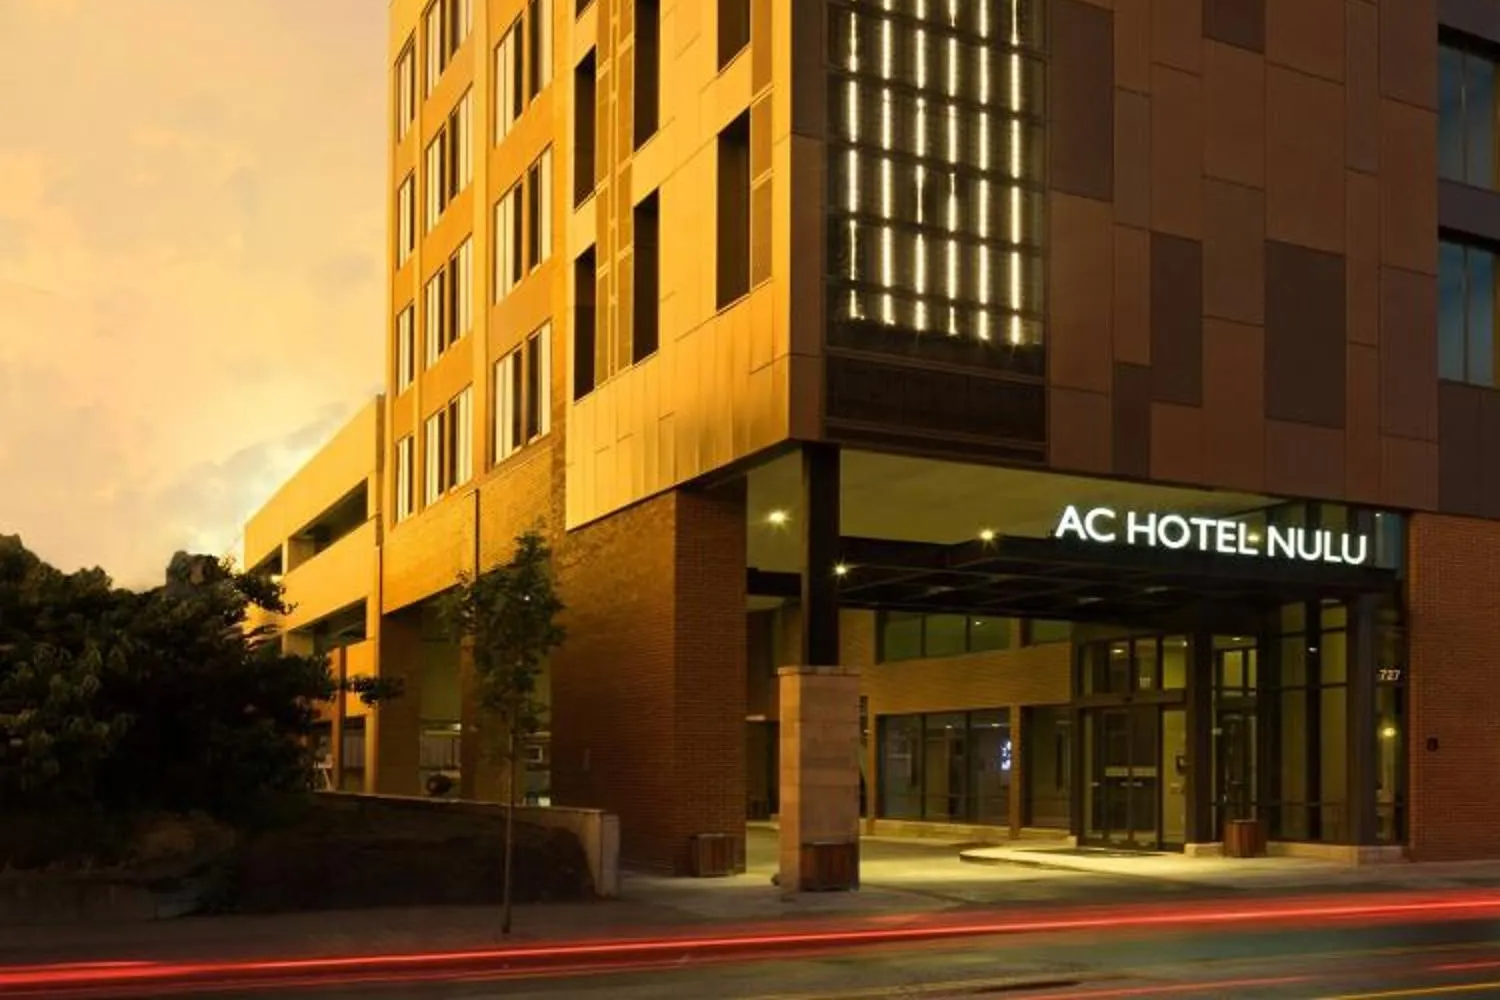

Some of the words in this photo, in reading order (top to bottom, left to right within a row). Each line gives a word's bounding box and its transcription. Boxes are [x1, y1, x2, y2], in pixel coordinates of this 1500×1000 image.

[1056, 505, 1116, 543] AC
[1126, 511, 1258, 555] HOTEL
[1267, 525, 1367, 565] NULU
[1379, 669, 1400, 681] 727
